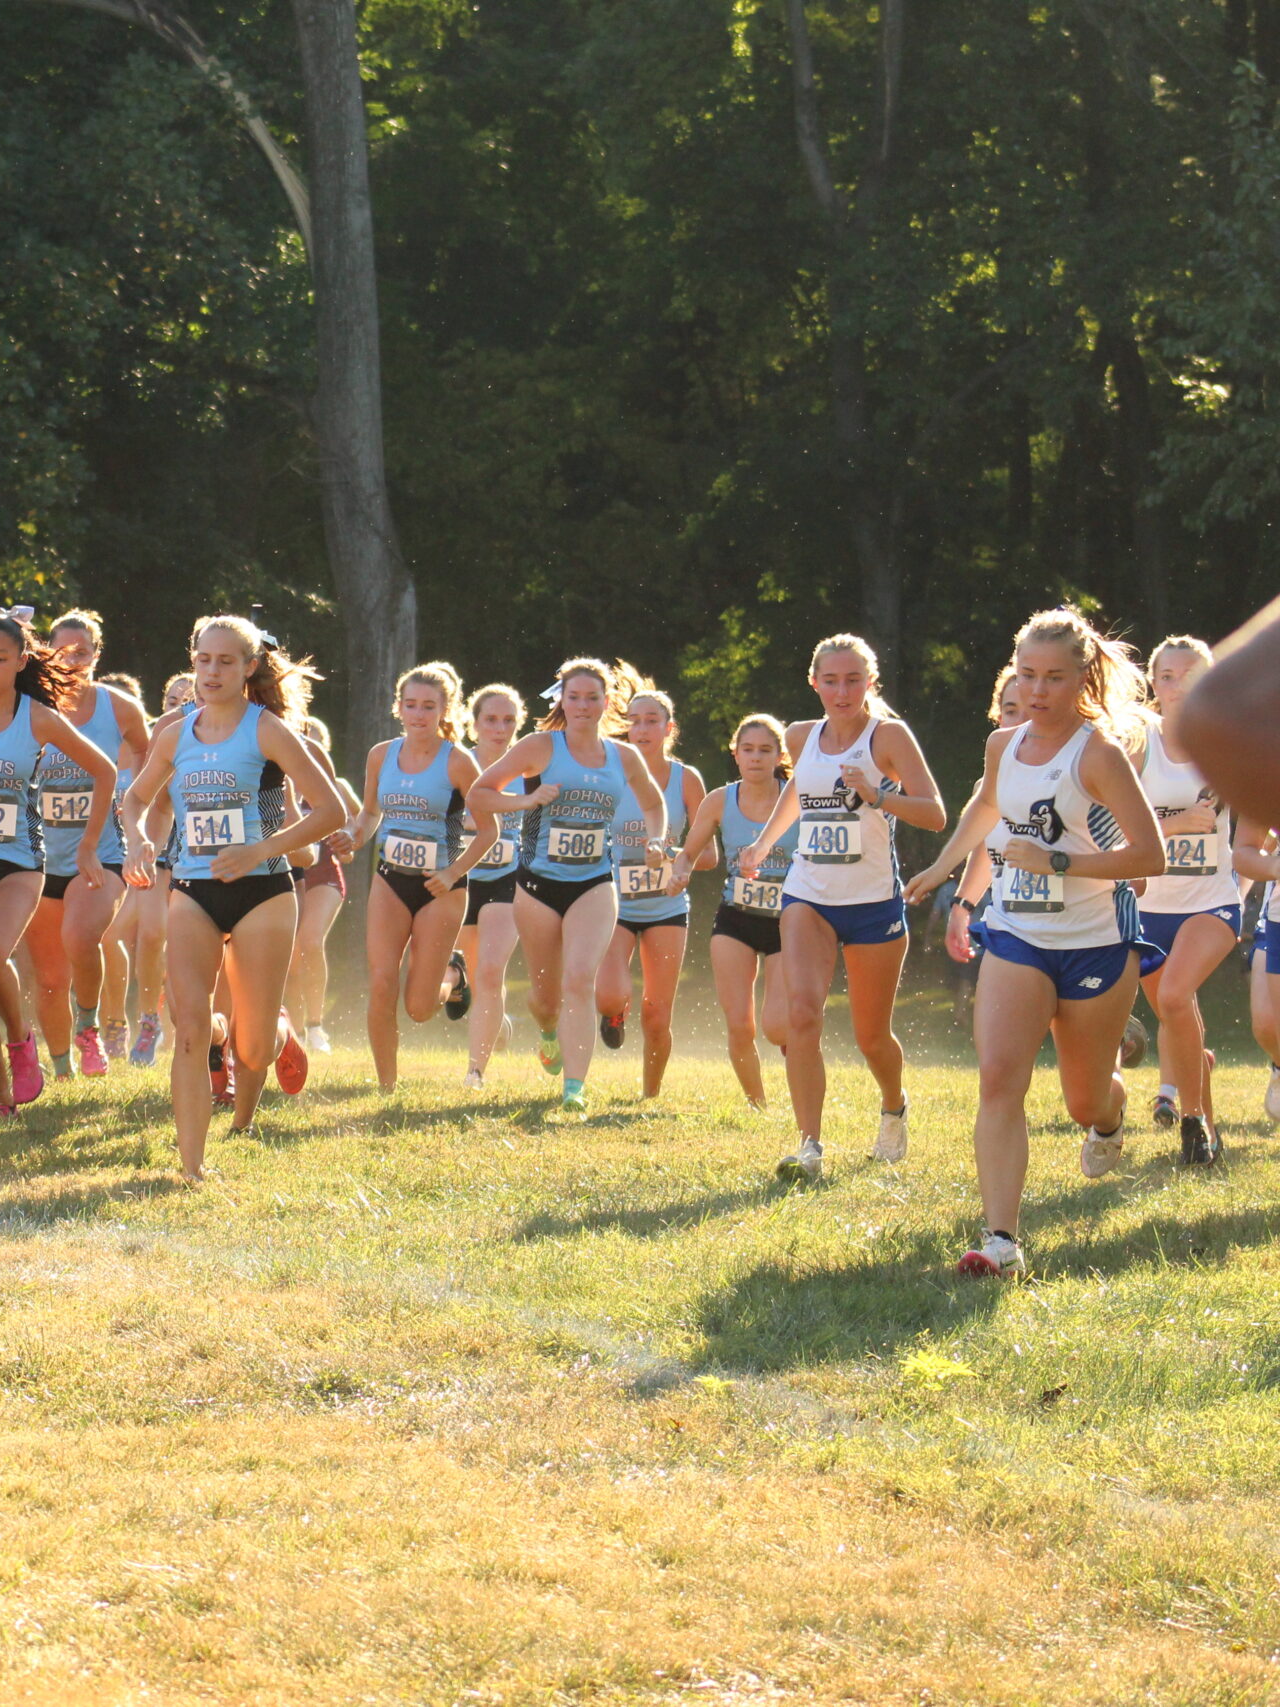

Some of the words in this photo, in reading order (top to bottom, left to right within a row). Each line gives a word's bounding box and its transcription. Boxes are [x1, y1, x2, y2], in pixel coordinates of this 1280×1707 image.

[183, 769, 237, 789] JOHNS
[51, 796, 89, 820] 512
[382, 792, 429, 811] JOHNS
[564, 789, 614, 809] JOHNS
[548, 804, 616, 823] HOPKINS
[192, 814, 233, 846] 514
[807, 825, 849, 854] 430
[391, 841, 427, 868] 498
[557, 832, 597, 858] 508
[1166, 839, 1207, 866] 424
[628, 867, 664, 892] 517
[1009, 867, 1051, 900] 434
[741, 882, 779, 909] 513
